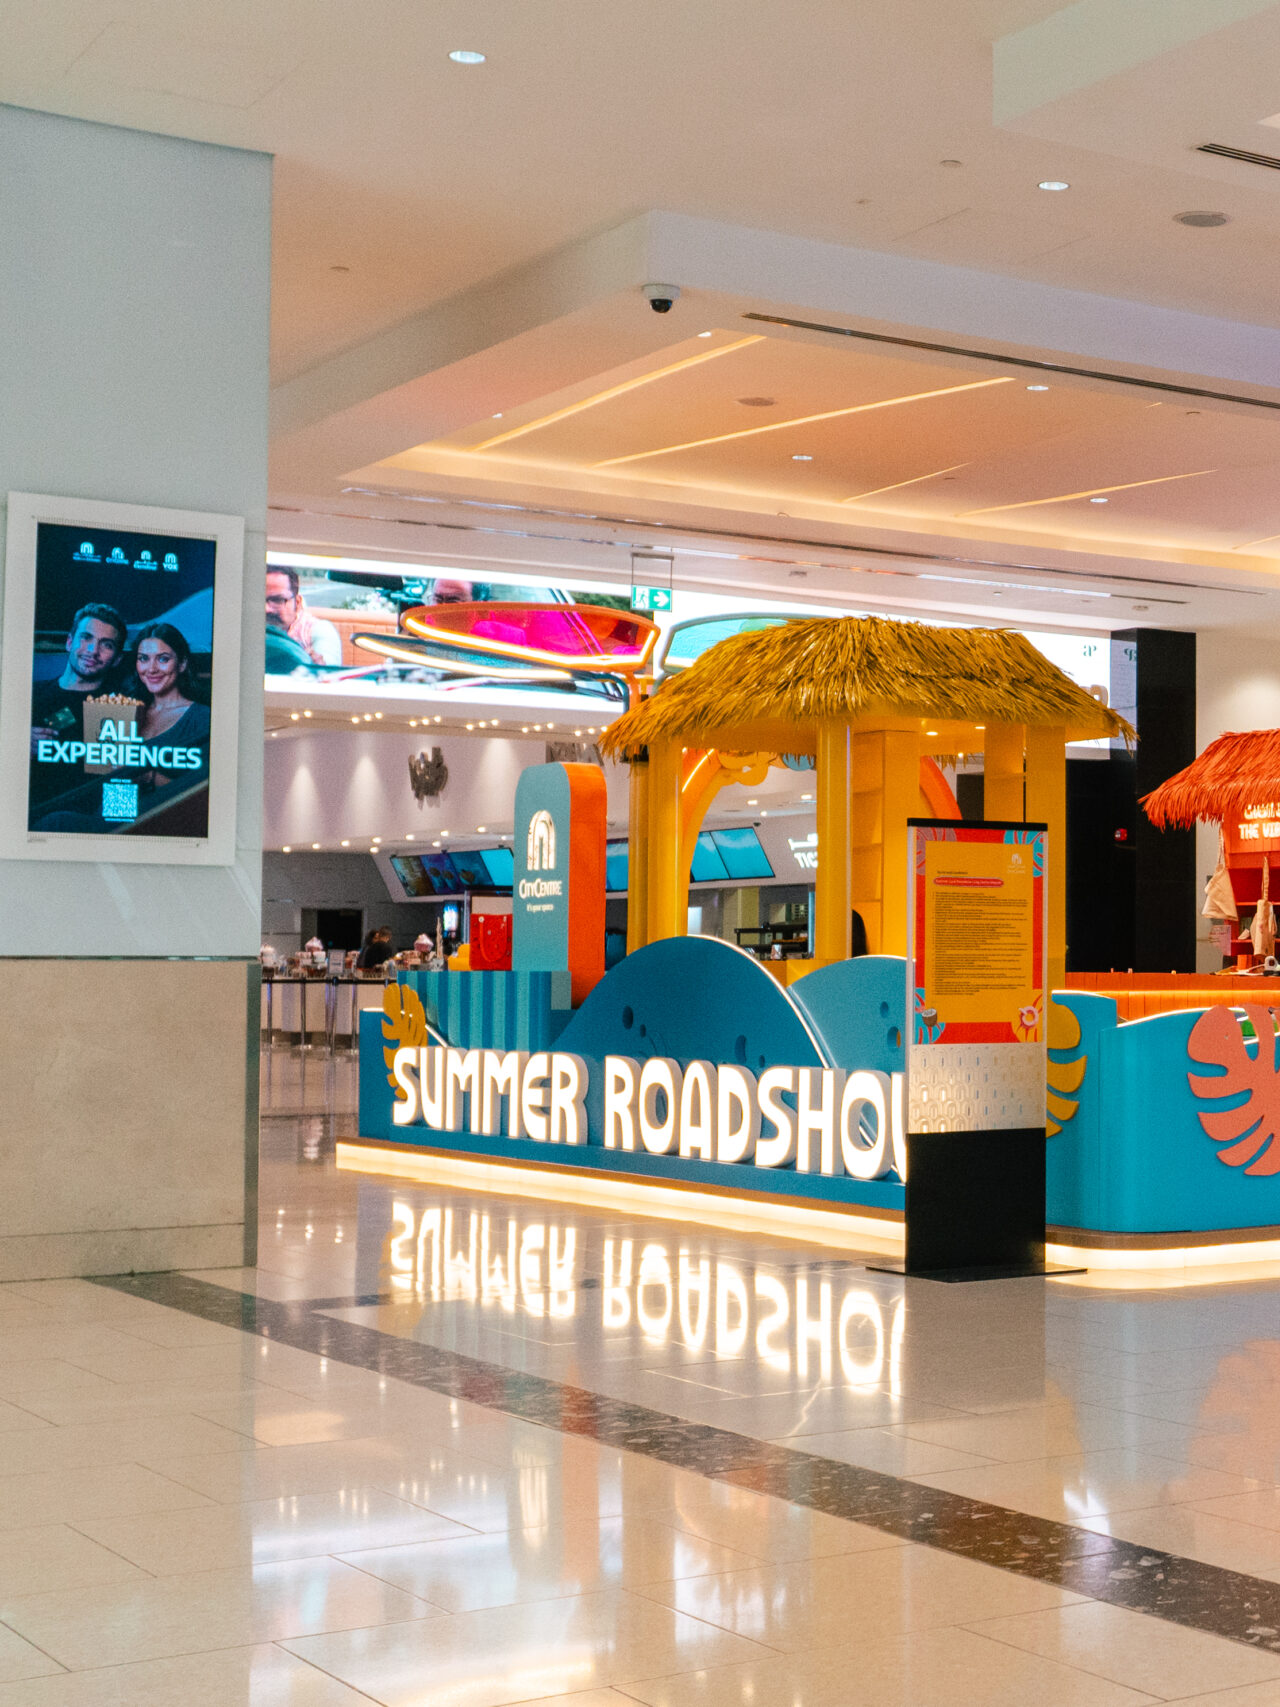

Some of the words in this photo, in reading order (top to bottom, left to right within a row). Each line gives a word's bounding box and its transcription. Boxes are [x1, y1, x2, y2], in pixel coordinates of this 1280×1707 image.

[99, 719, 144, 743] ALL
[37, 739, 203, 769] EXPERIENCES
[1238, 823, 1259, 840] THE
[393, 1045, 588, 1146] SUMMER
